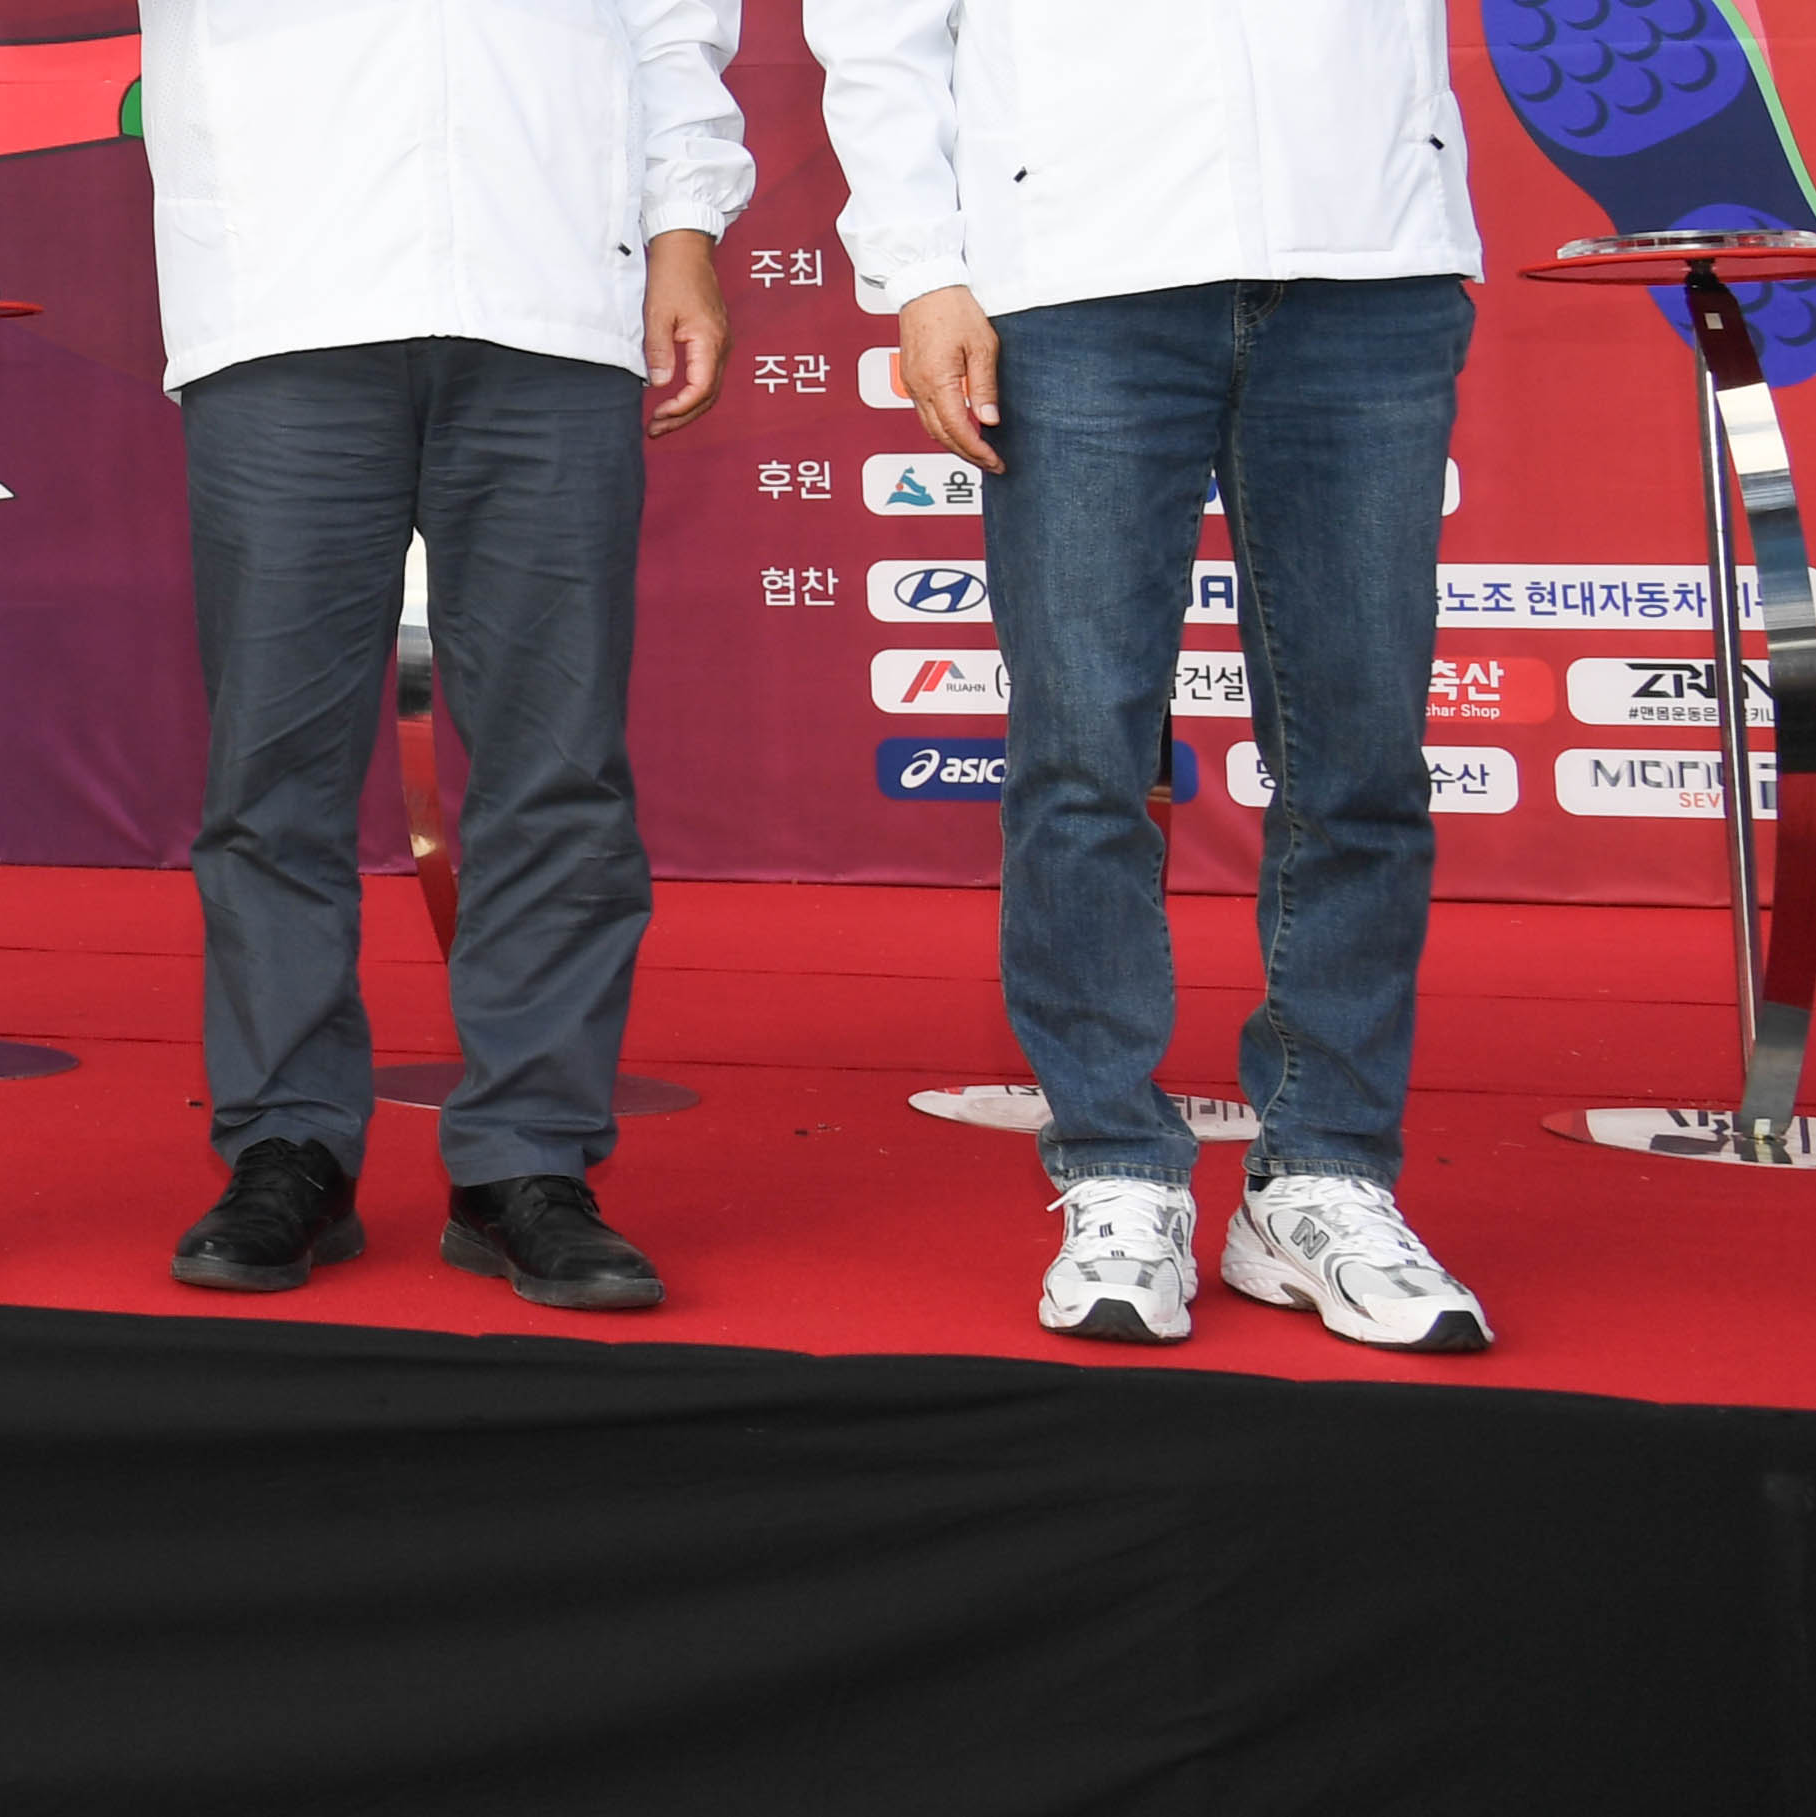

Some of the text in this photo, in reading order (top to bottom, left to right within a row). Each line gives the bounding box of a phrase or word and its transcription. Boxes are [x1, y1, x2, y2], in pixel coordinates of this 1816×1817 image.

[750, 248, 823, 288] 주최
[753, 354, 830, 393] 주관
[757, 460, 832, 500] 후원
[760, 566, 839, 606] 협찬
[1437, 581, 1516, 615] 노조
[1524, 581, 1707, 618] 현대자동차
[946, 683, 986, 693] RUAHN
[1461, 703, 1501, 720] Shop
